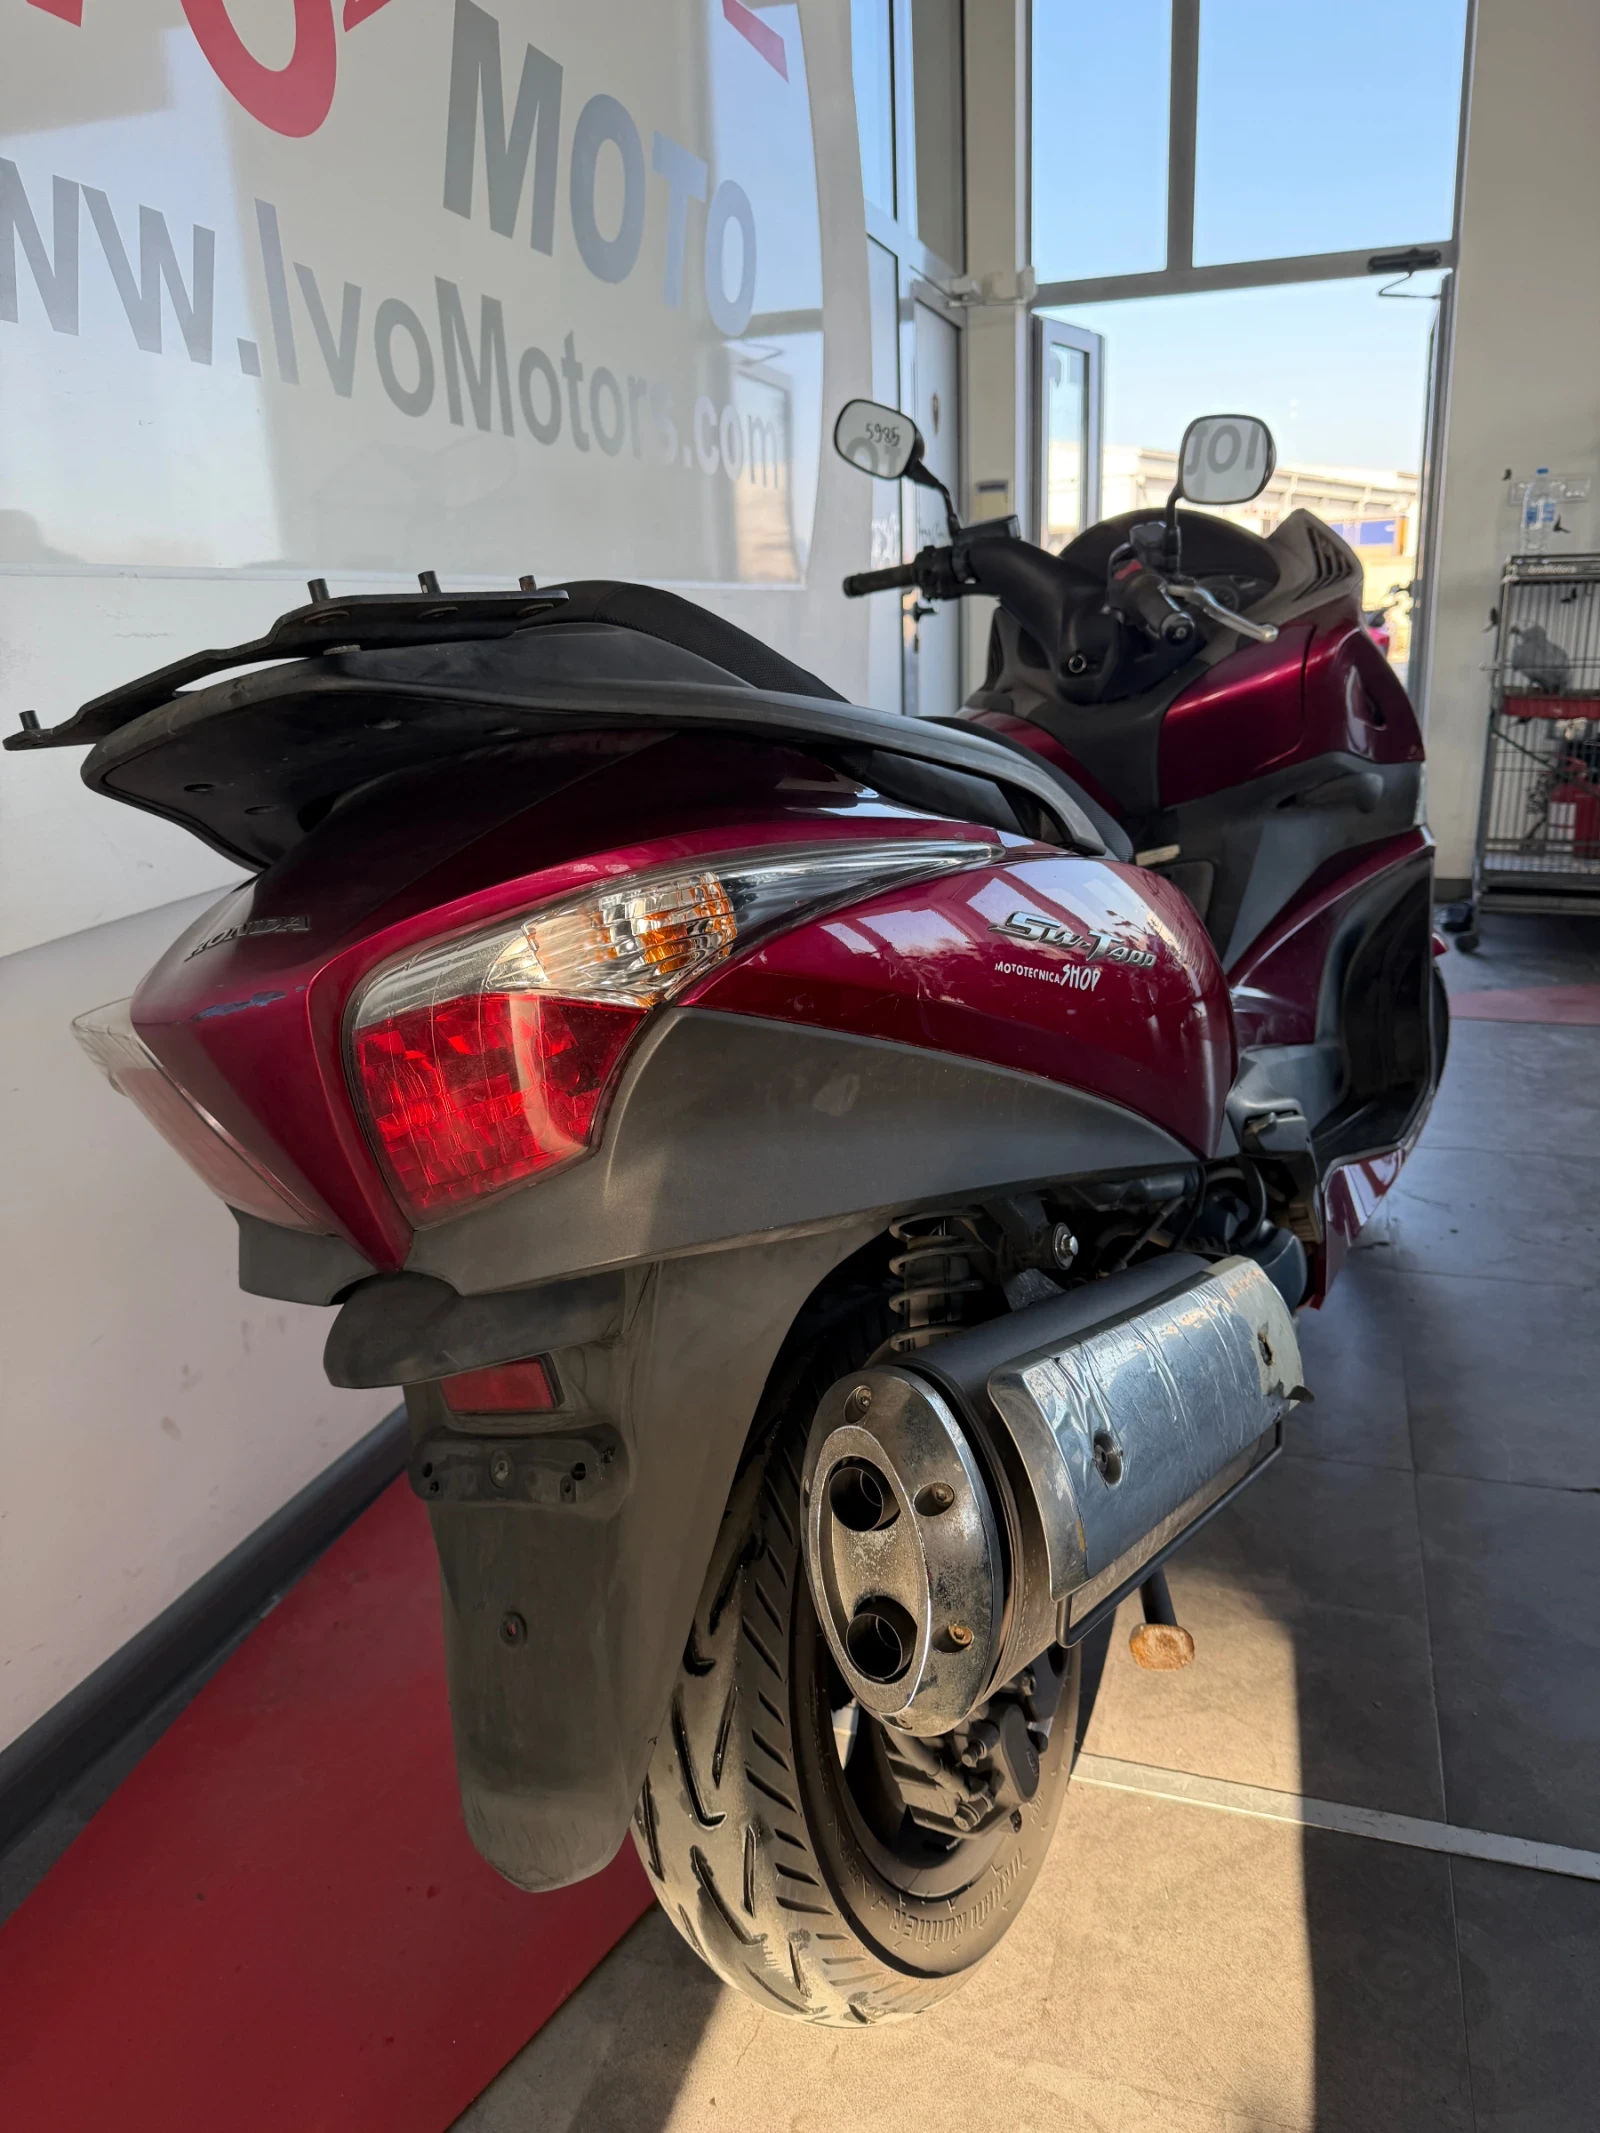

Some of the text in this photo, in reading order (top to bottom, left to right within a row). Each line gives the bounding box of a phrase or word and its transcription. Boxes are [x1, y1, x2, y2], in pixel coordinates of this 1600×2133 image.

[443, 0, 756, 336] MOTO
[184, 916, 311, 962] HONDA
[1060, 964, 1102, 992] SHOP
